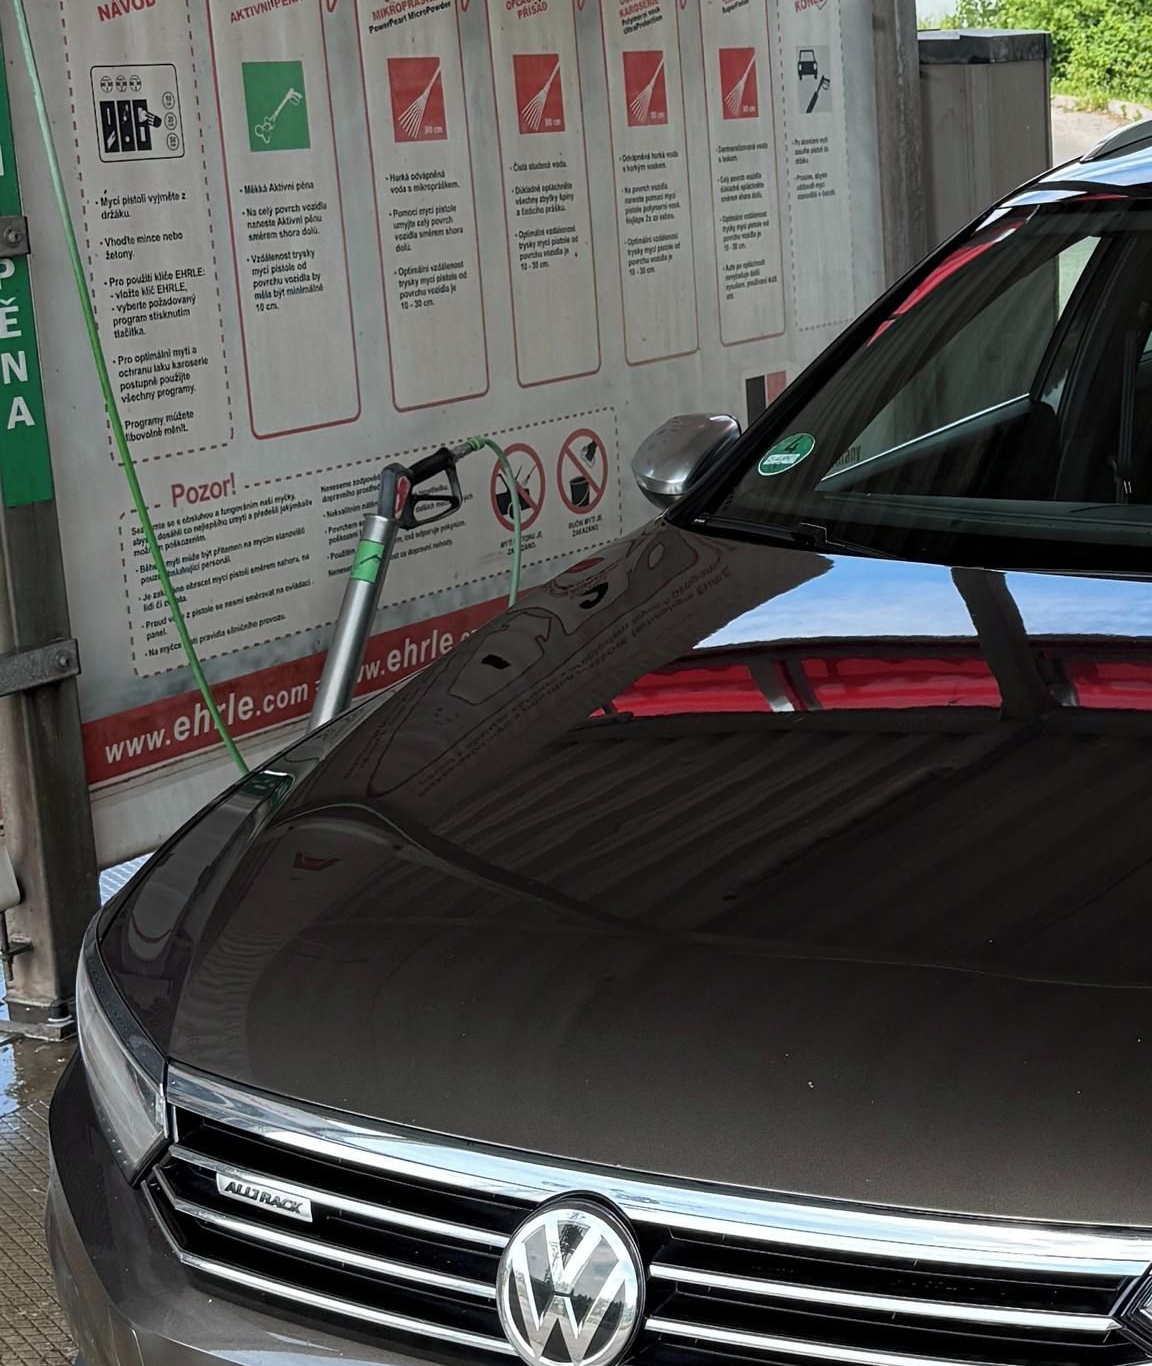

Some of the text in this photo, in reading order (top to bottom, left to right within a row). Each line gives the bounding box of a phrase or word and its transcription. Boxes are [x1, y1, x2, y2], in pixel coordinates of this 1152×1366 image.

[163, 231, 183, 240] nebo
[109, 277, 124, 287] Pro
[113, 314, 147, 327] program
[118, 355, 132, 365] Pro
[125, 416, 164, 430] Programy
[171, 472, 236, 507] Pozor!
[224, 1179, 305, 1216] ALLTRACK
